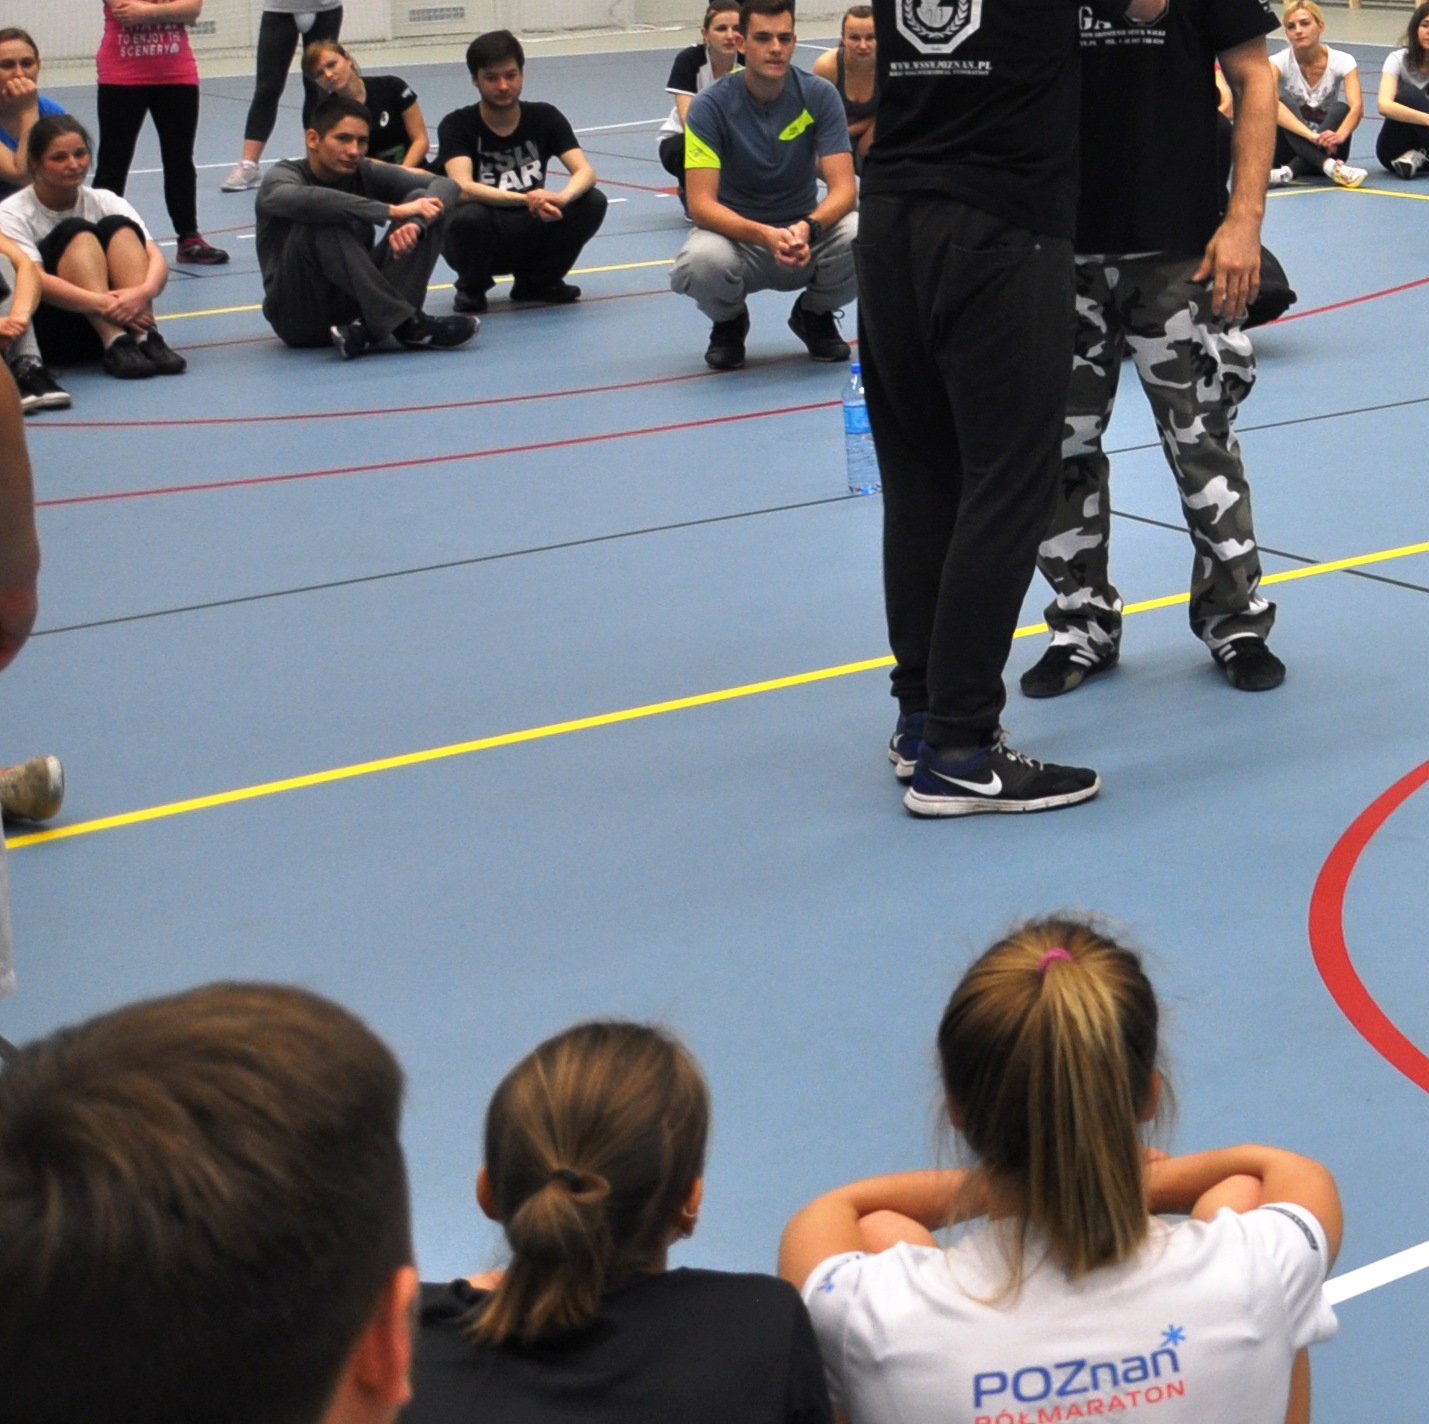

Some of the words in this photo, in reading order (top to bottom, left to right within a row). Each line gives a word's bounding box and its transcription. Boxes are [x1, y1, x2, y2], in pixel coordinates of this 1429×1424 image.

[118, 34, 130, 45] TO
[133, 33, 165, 44] ENJOY
[120, 44, 171, 57] SCENERY
